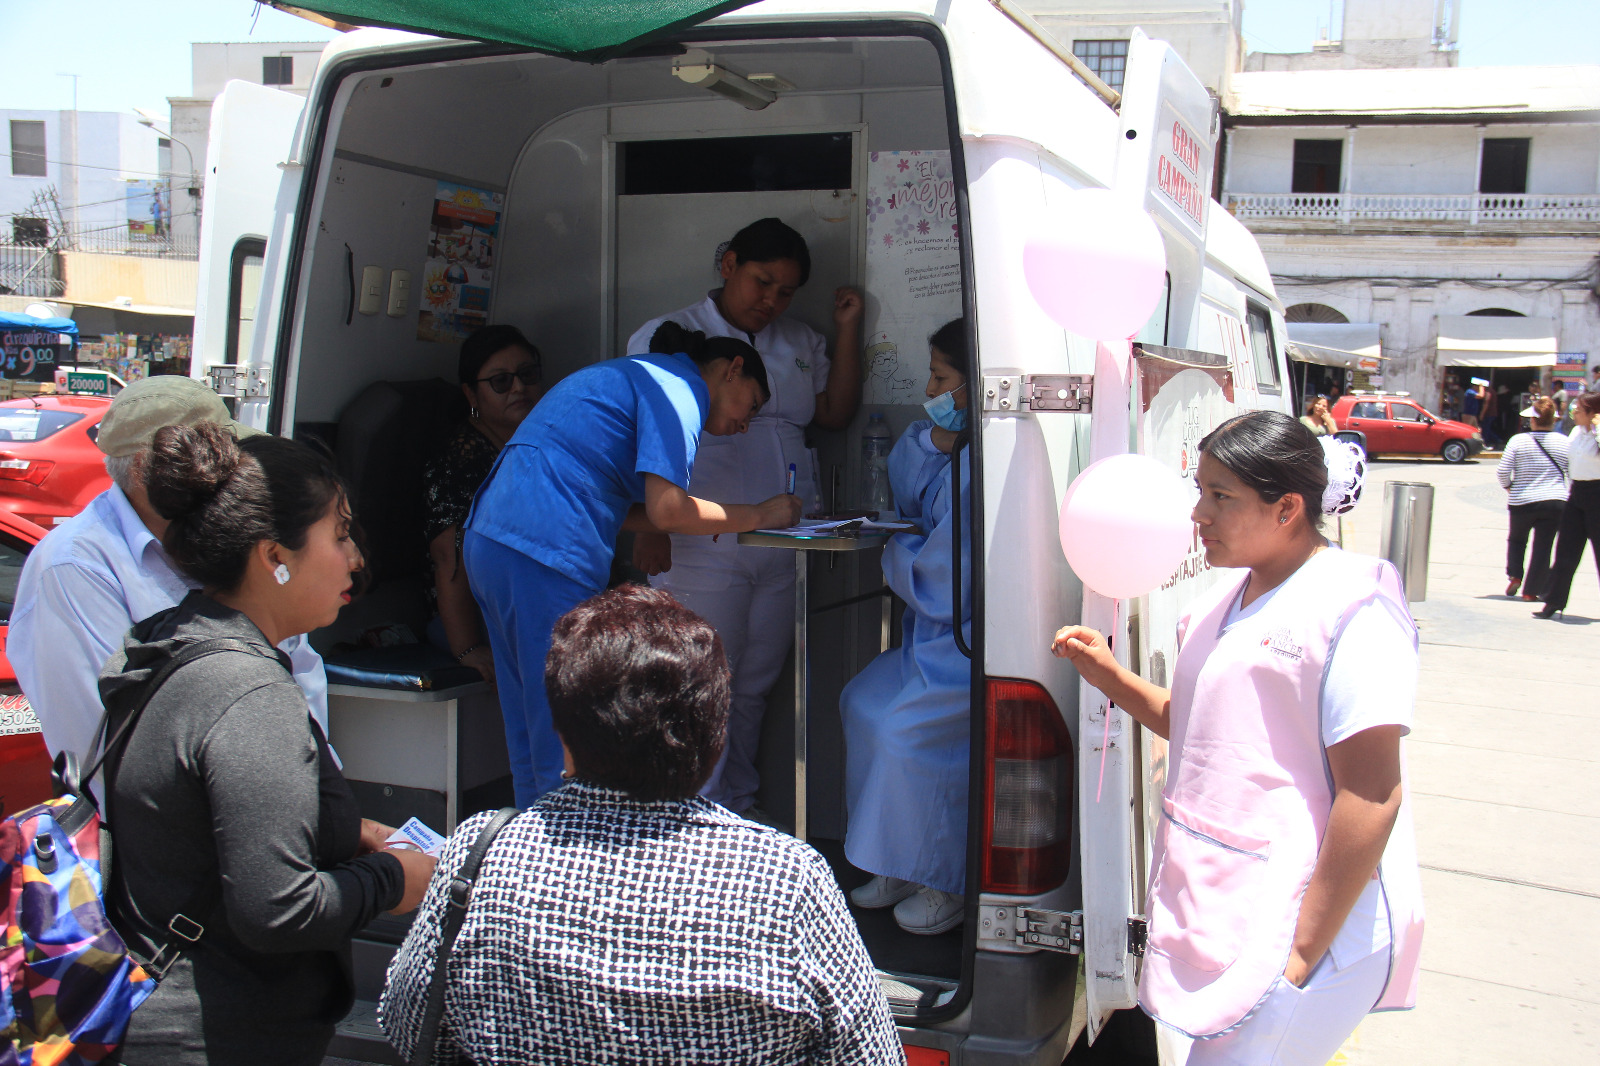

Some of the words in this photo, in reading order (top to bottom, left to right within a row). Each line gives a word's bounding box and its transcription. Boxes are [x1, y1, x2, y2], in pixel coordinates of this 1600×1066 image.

[1172, 121, 1200, 178] GRAN
[919, 161, 934, 177] El
[898, 180, 955, 213] mejor
[1158, 154, 1203, 227] CAMPAÑA
[70, 379, 104, 391] 200000
